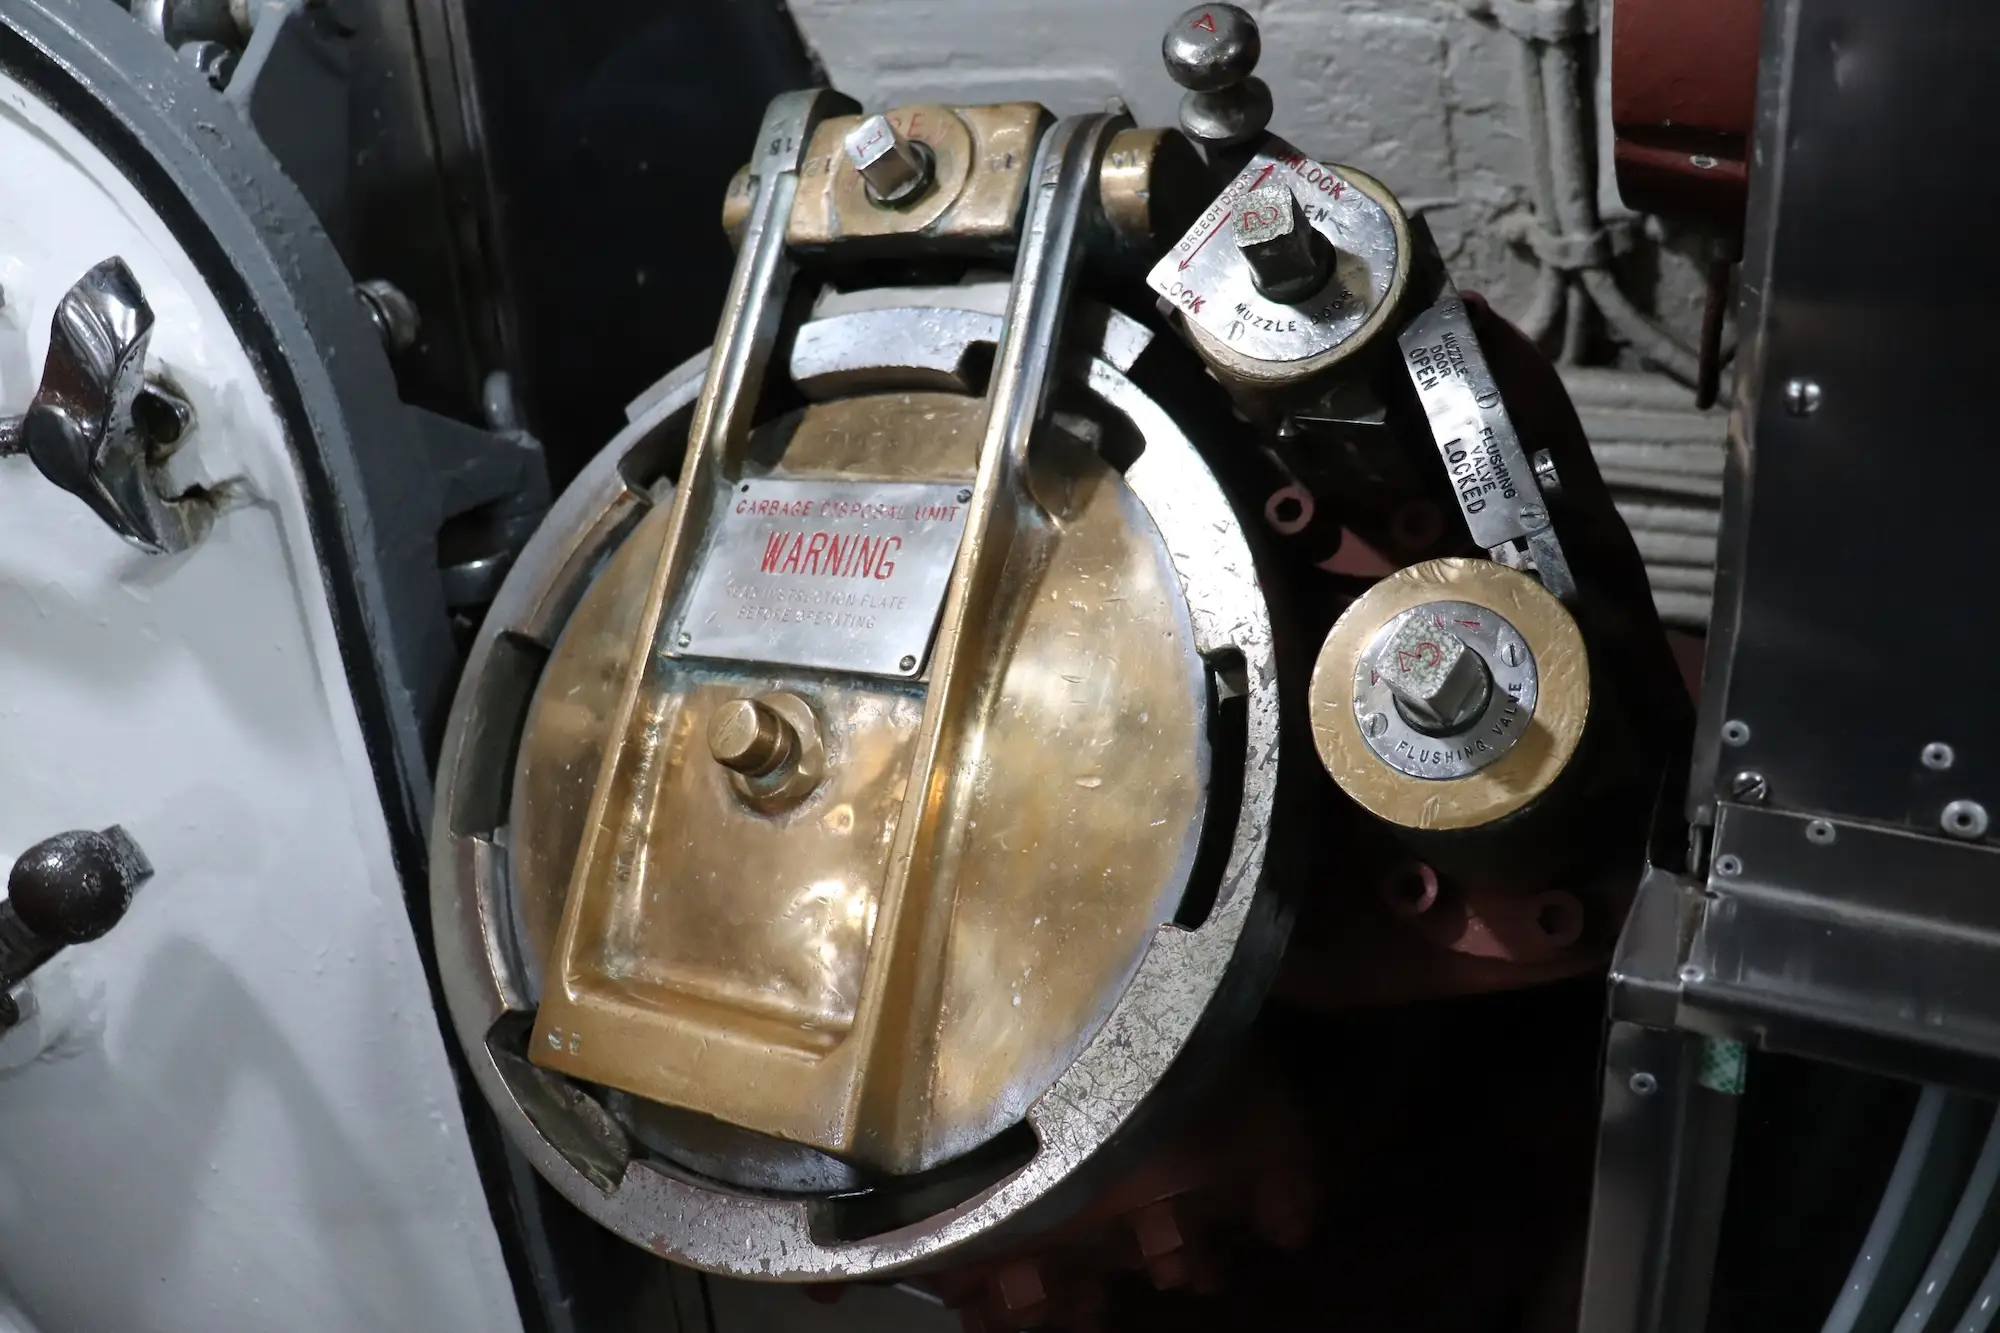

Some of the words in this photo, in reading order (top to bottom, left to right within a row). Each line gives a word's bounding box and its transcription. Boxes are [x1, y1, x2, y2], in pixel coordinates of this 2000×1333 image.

[1180, 203, 1224, 252] BREECH
[1159, 280, 1207, 314] LOCK
[1234, 302, 1297, 332] MUZZLE
[1311, 290, 1353, 325] DOOR
[1408, 347, 1439, 392] OPEN
[1430, 344, 1452, 379] DOOR
[1441, 331, 1468, 378] MUZZLE
[1443, 438, 1487, 515] LOCKED
[1469, 445, 1497, 495] VALVE
[1478, 427, 1516, 500] FLUSHING
[736, 499, 814, 517] GARBAGE
[914, 505, 961, 521] UNIT
[761, 530, 903, 580] WARNING
[736, 605, 790, 623] BEFORE
[795, 609, 877, 629] OPERATING
[860, 595, 908, 611] PLATE
[1395, 740, 1489, 764] FLUSHING
[1492, 682, 1523, 736] VALVE
